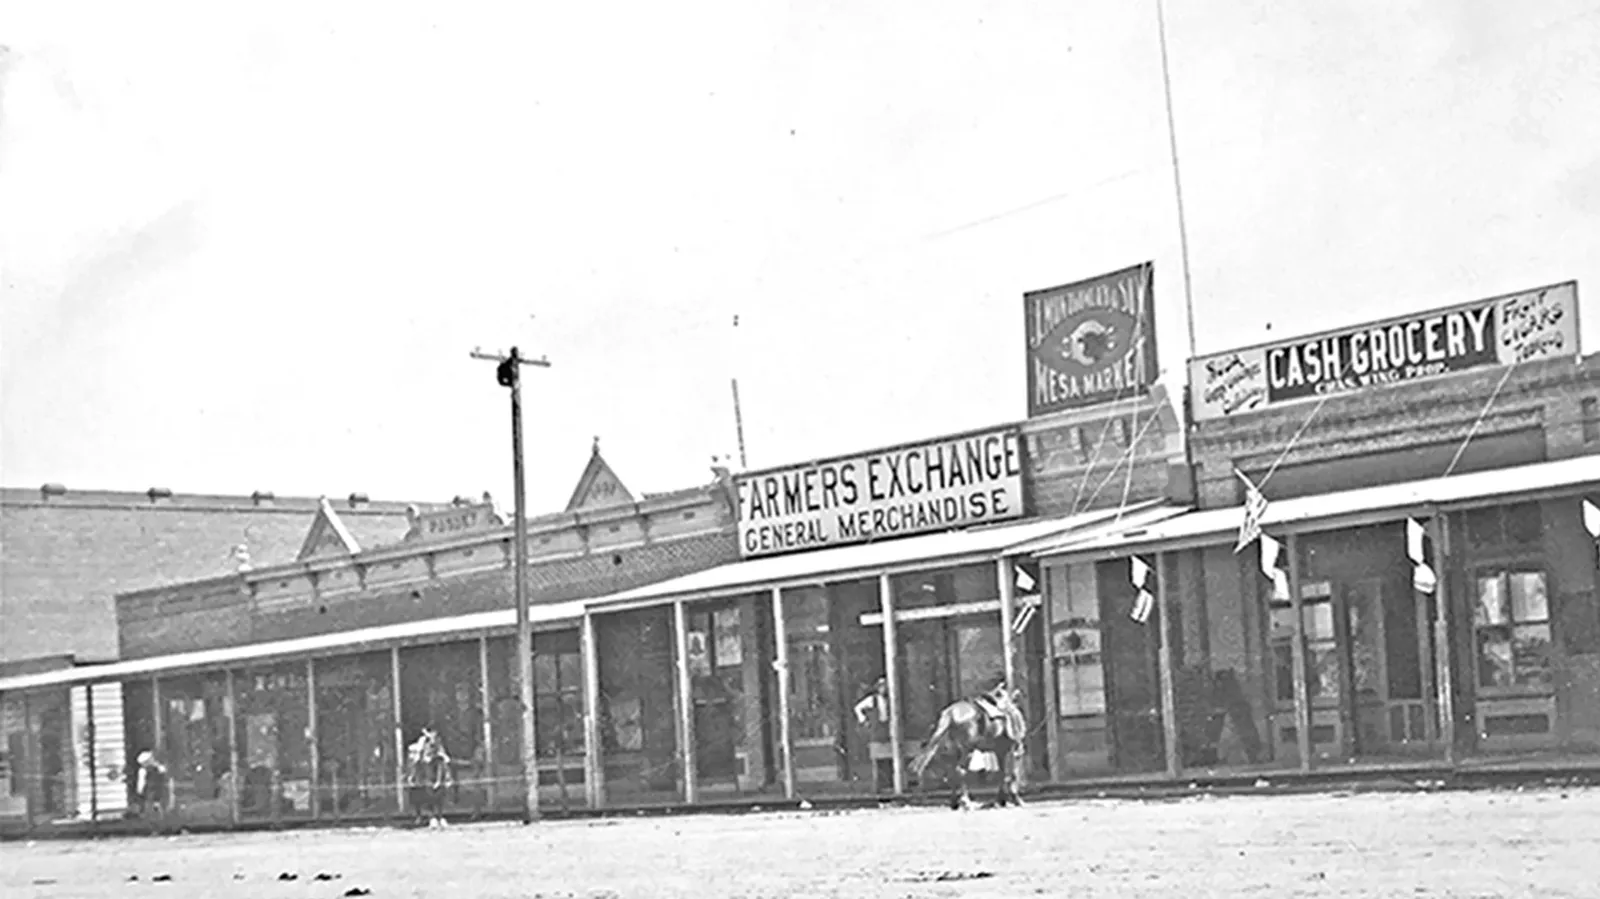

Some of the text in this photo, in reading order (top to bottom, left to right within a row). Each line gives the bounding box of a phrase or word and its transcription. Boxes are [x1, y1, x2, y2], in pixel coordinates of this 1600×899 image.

[1034, 356, 1080, 405] MESA
[1269, 338, 1342, 390] CASH
[1350, 306, 1494, 374] GROCERY
[736, 432, 1020, 520] FARMERS EXCHANGE
[745, 488, 1010, 552] GENERAL MERCHANDISE
